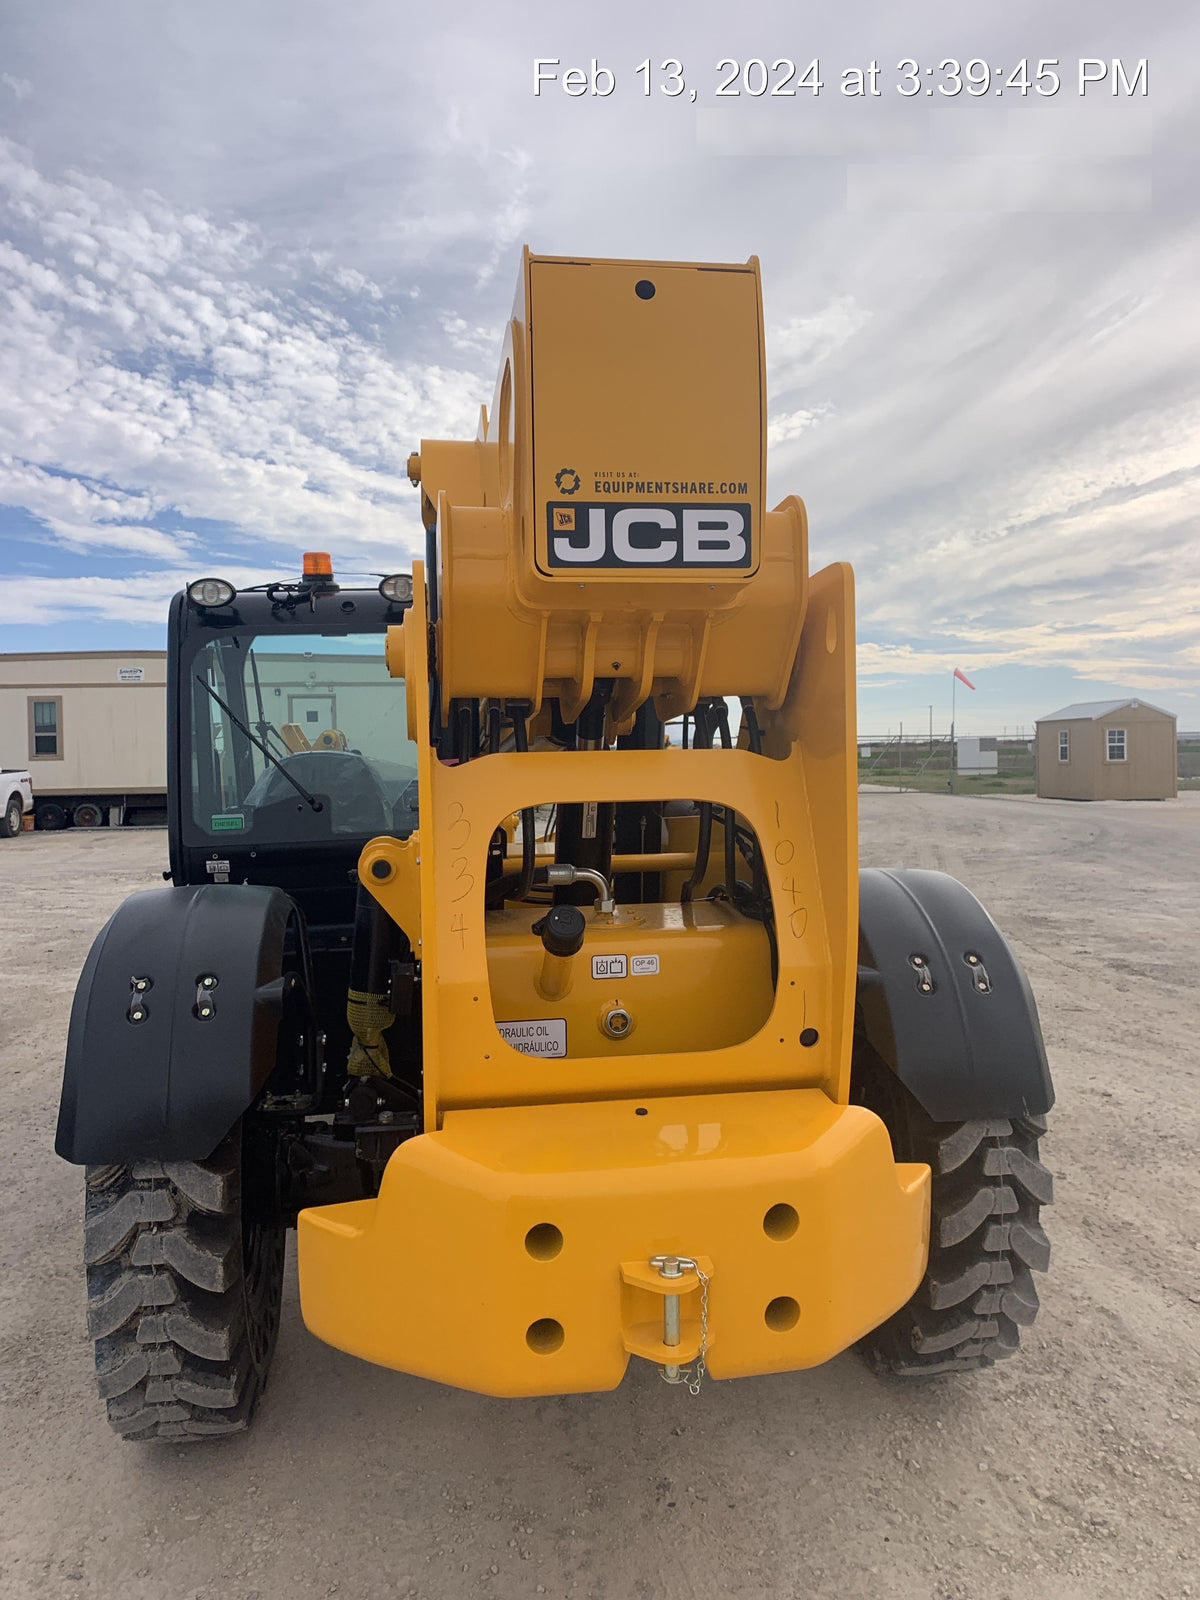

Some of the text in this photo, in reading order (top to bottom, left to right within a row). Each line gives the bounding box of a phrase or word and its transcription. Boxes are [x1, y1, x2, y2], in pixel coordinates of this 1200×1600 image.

[594, 481, 748, 494] EQUIPMENTSHARE.COM
[553, 508, 747, 563] JCB
[635, 959, 646, 967] OP
[498, 1026, 550, 1039] DRAULIC OIL
